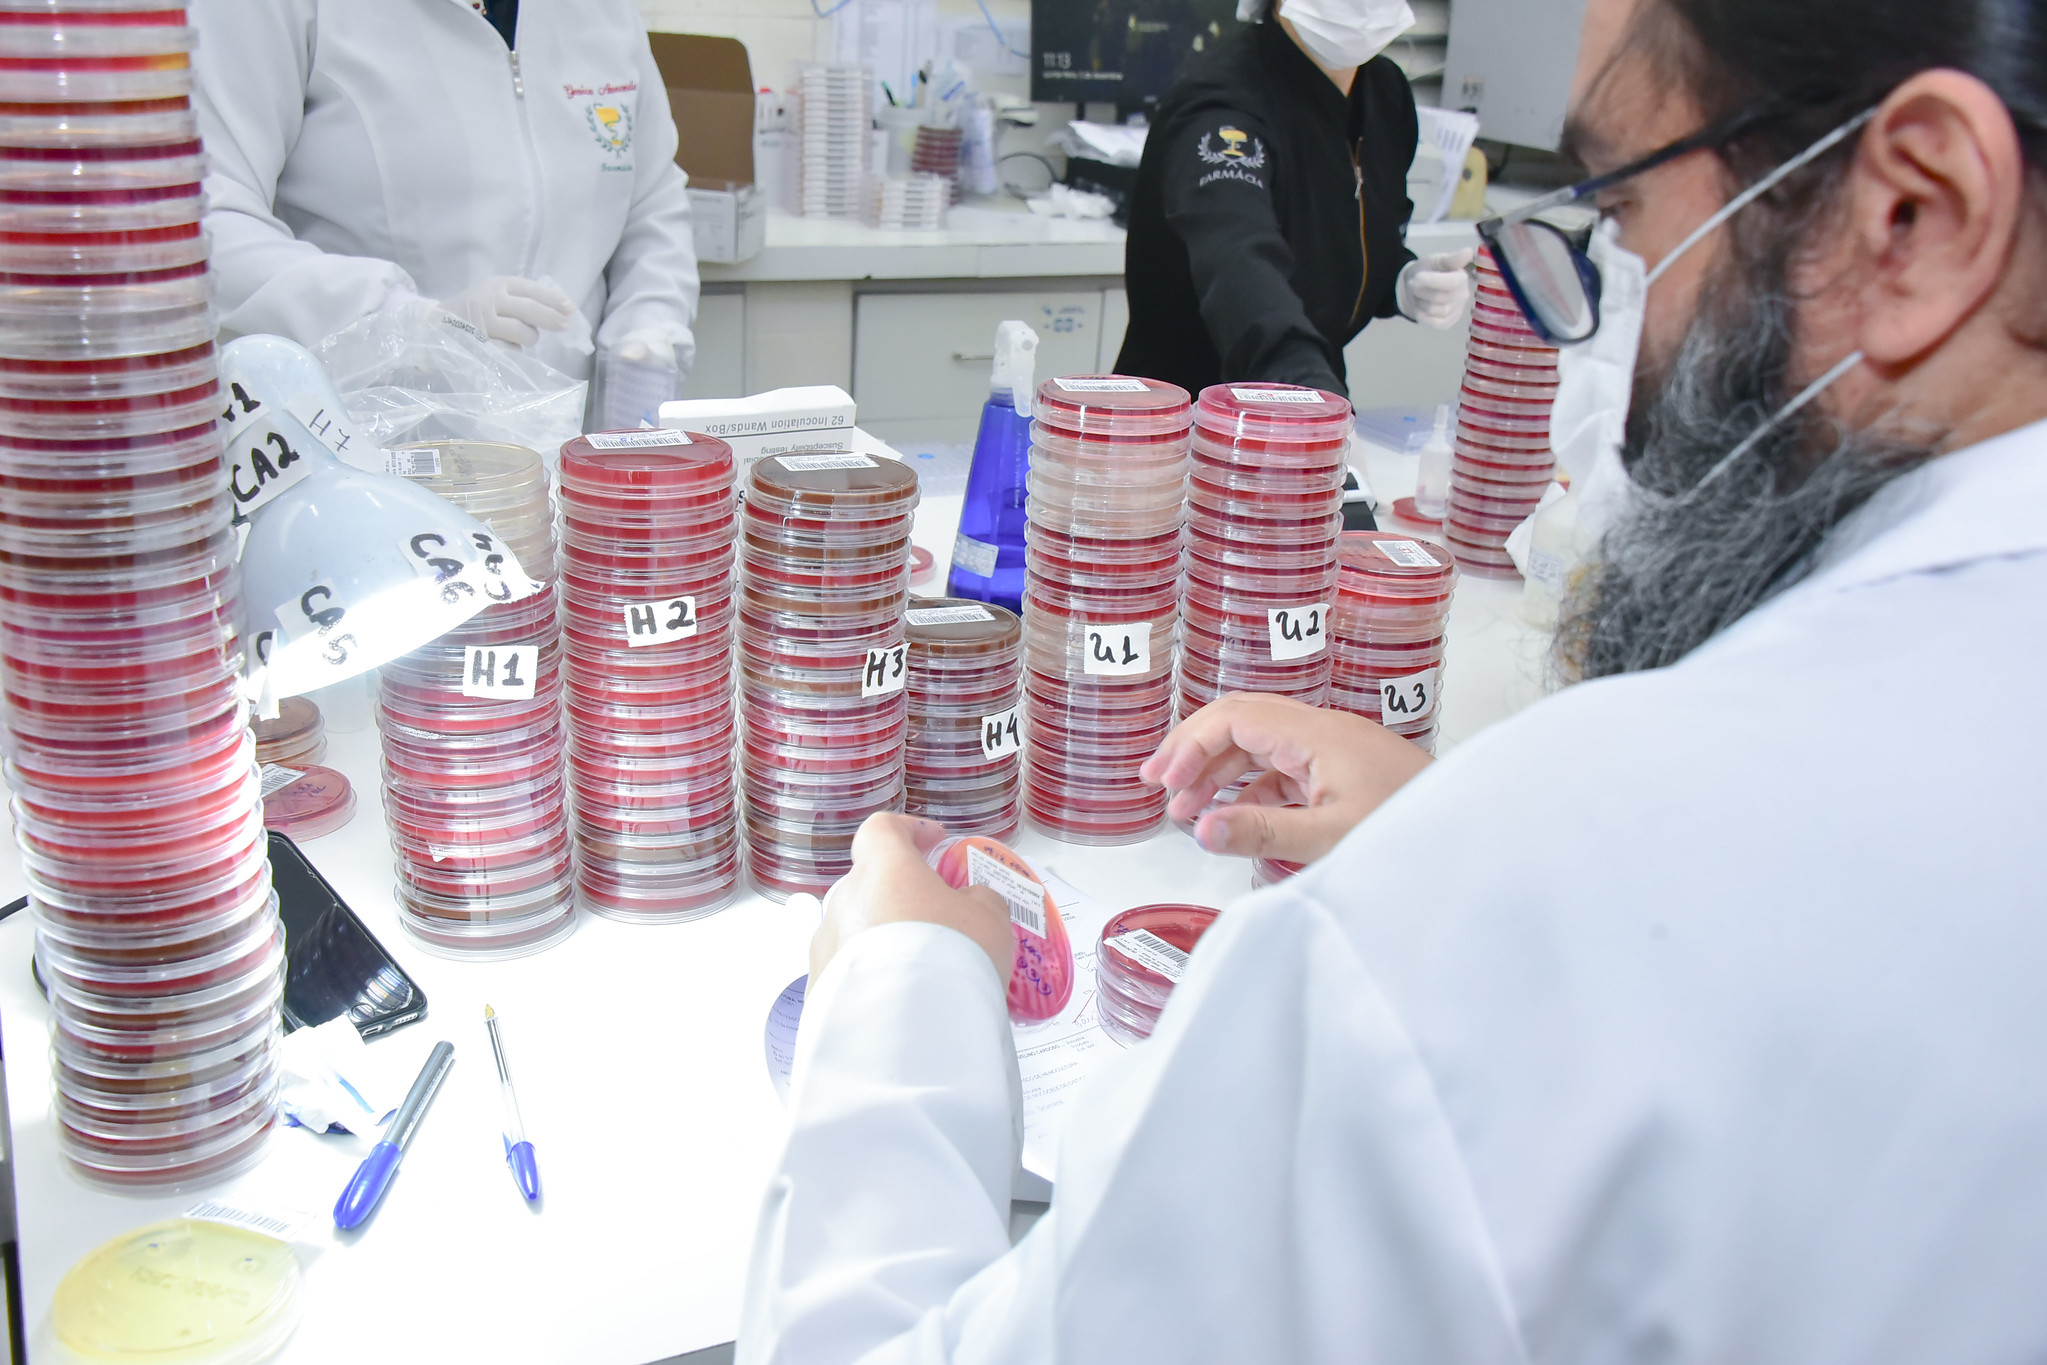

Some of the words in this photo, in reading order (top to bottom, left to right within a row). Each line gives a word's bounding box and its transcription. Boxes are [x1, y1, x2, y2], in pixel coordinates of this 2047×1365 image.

[705, 422, 767, 434] Wands/Box
[771, 417, 828, 429] Inoculation
[831, 415, 844, 426] 62
[230, 432, 300, 502] CA2
[630, 600, 695, 635] H2
[471, 649, 525, 687] H1
[866, 647, 904, 688] H3
[986, 712, 1020, 751] H4
